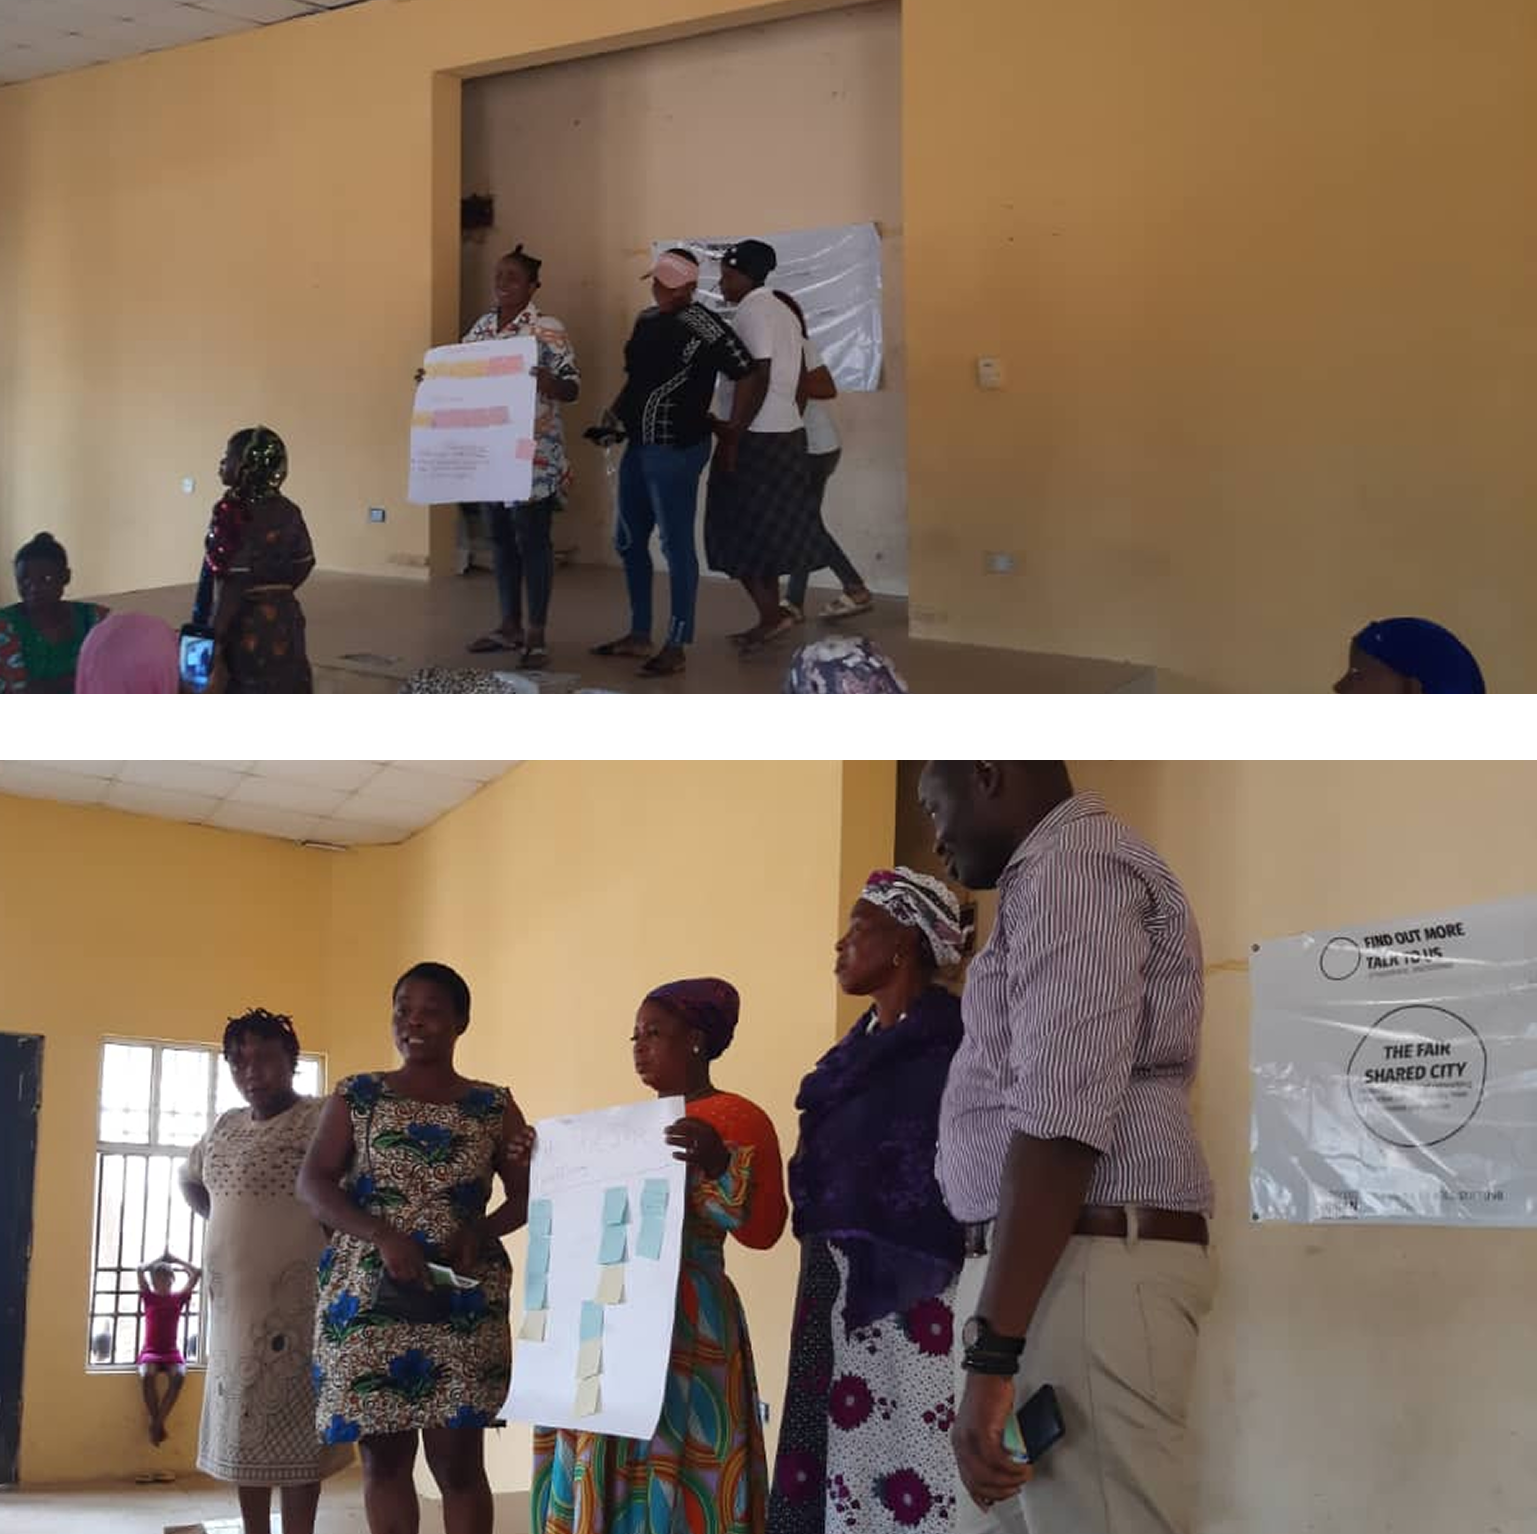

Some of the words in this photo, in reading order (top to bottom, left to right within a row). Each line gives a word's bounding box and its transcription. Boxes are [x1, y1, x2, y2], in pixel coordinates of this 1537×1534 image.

[1364, 934, 1393, 948] FIND
[1394, 929, 1421, 945] OUT
[1424, 922, 1466, 939] MORE
[1383, 1043, 1413, 1059] THE
[1365, 1065, 1426, 1084] SHARED
[1430, 1062, 1467, 1078] CITY
